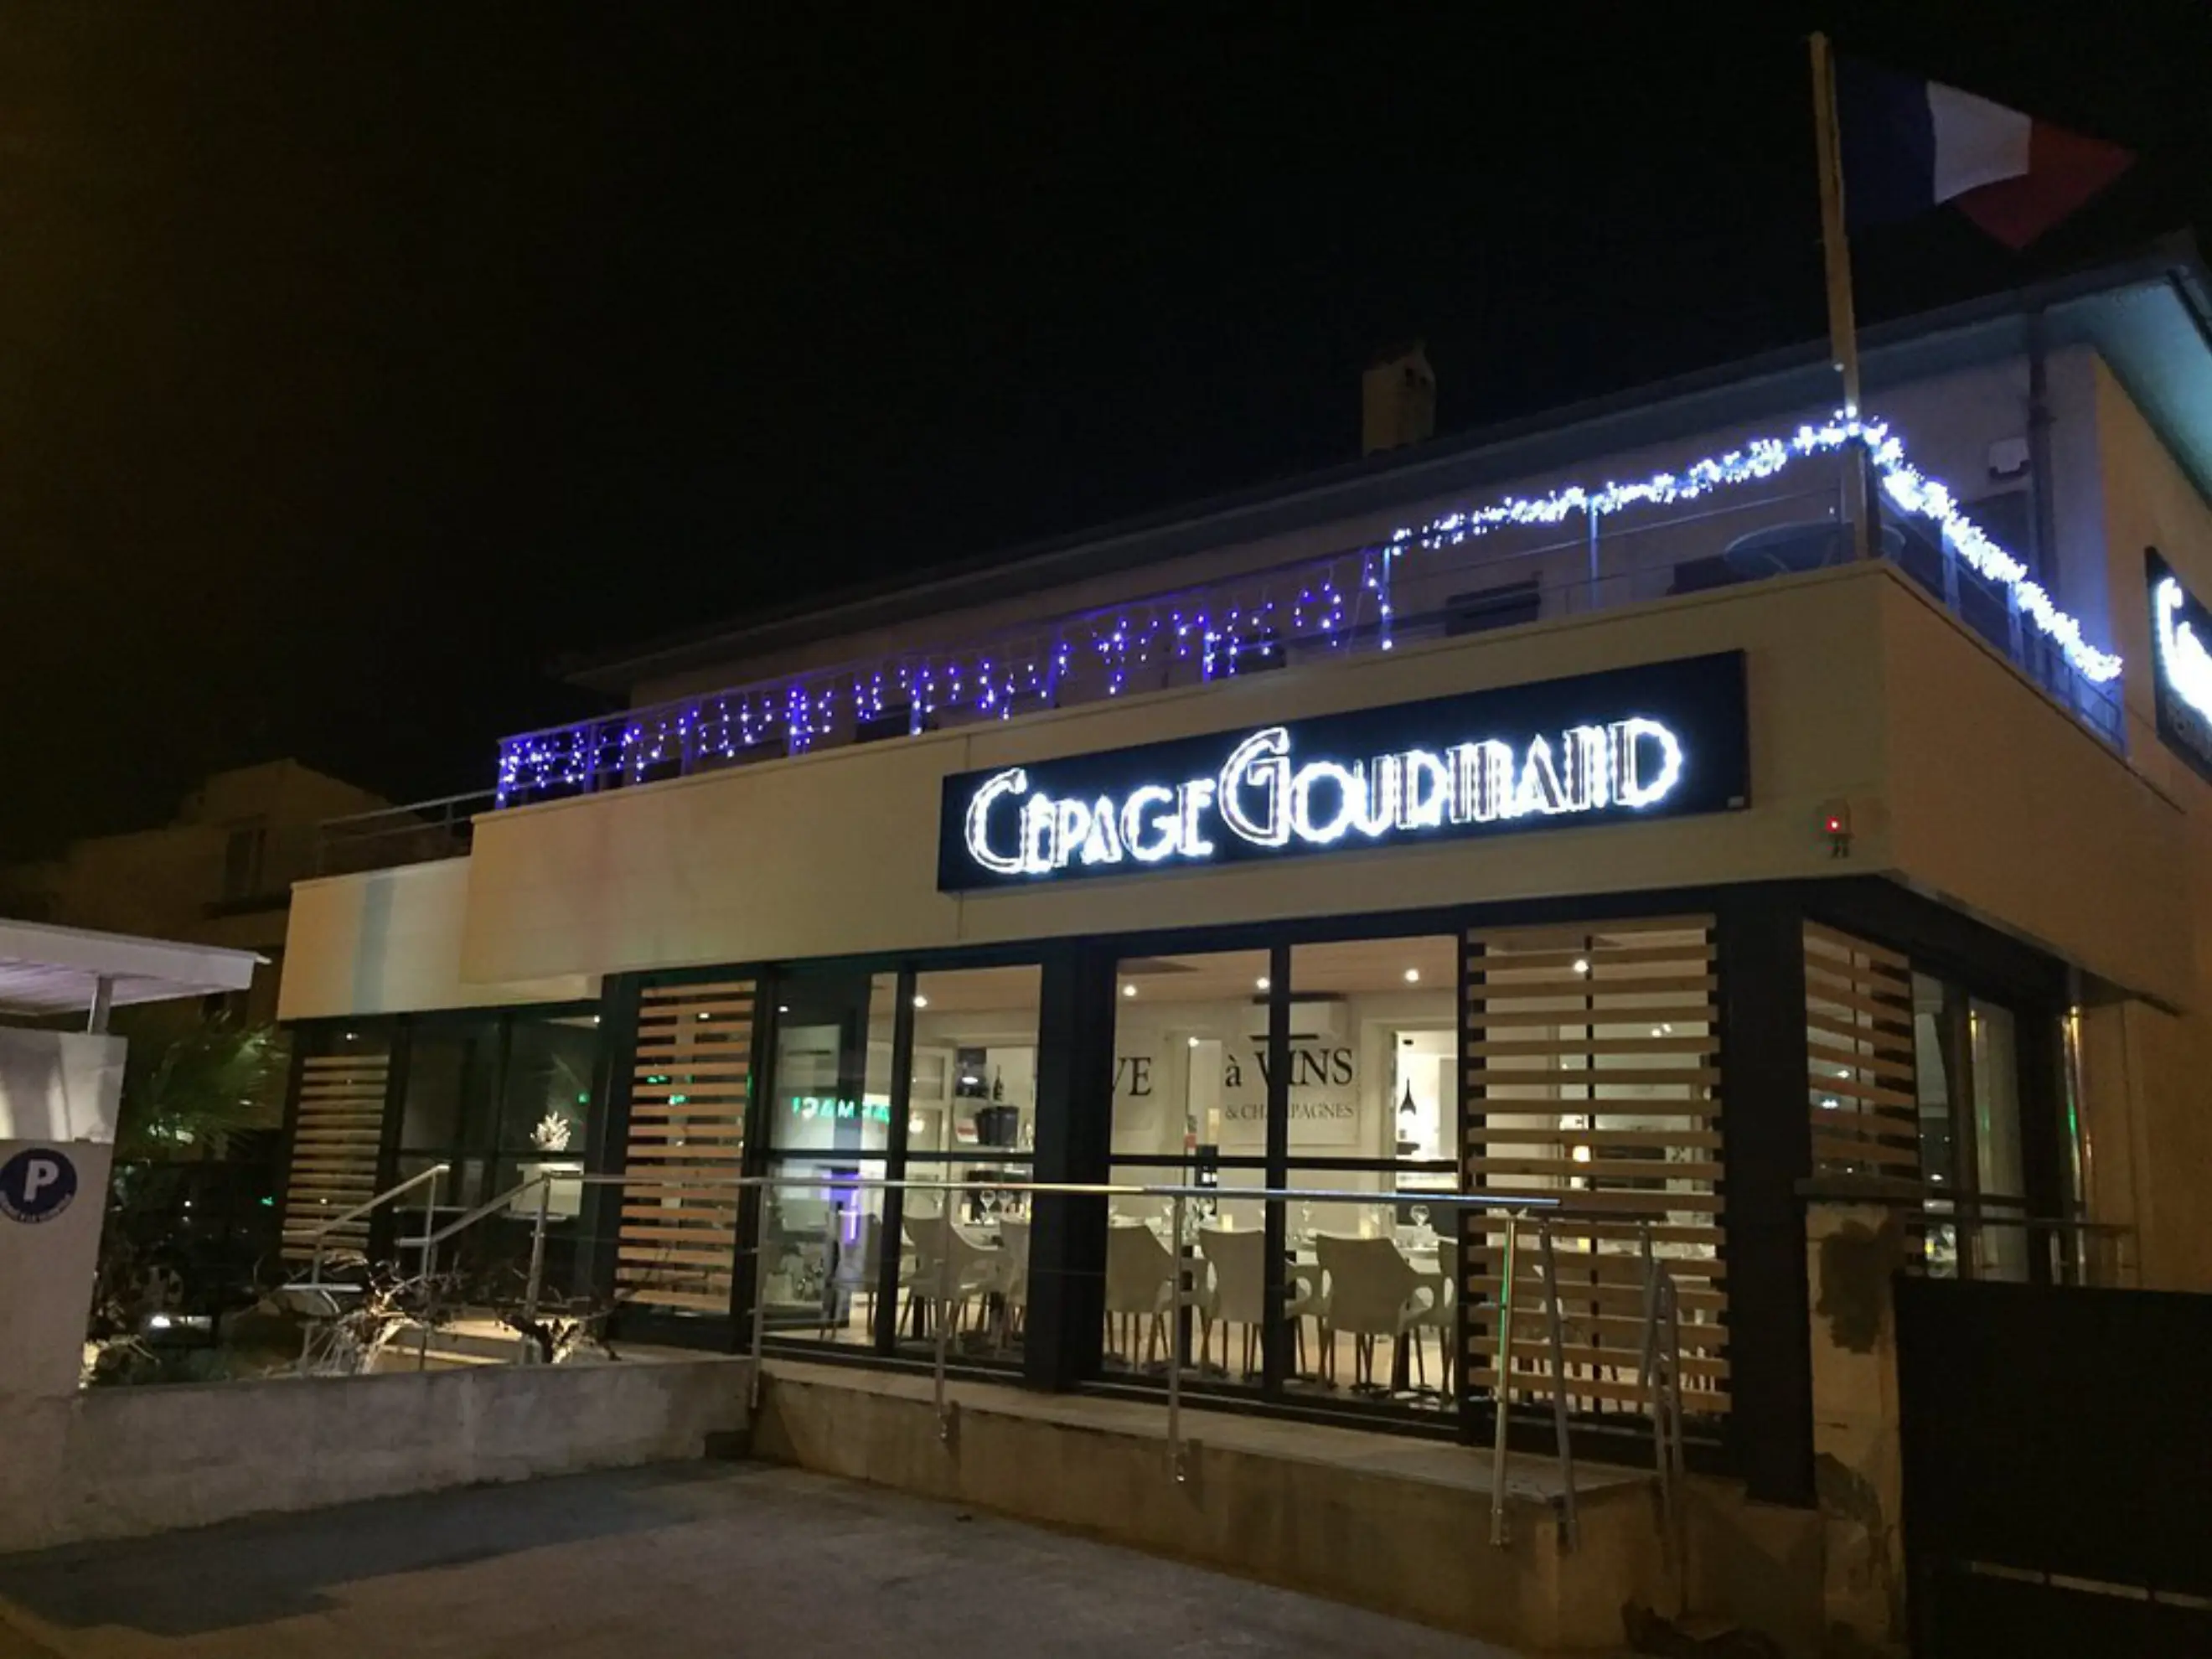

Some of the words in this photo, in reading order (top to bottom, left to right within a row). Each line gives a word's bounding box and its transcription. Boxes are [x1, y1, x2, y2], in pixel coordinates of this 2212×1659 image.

[1218, 717, 1682, 846] GOURMAND
[1225, 1053, 1243, 1088] à
[1240, 1101, 1355, 1120] CHPAGNES
[23, 1159, 59, 1202] P
